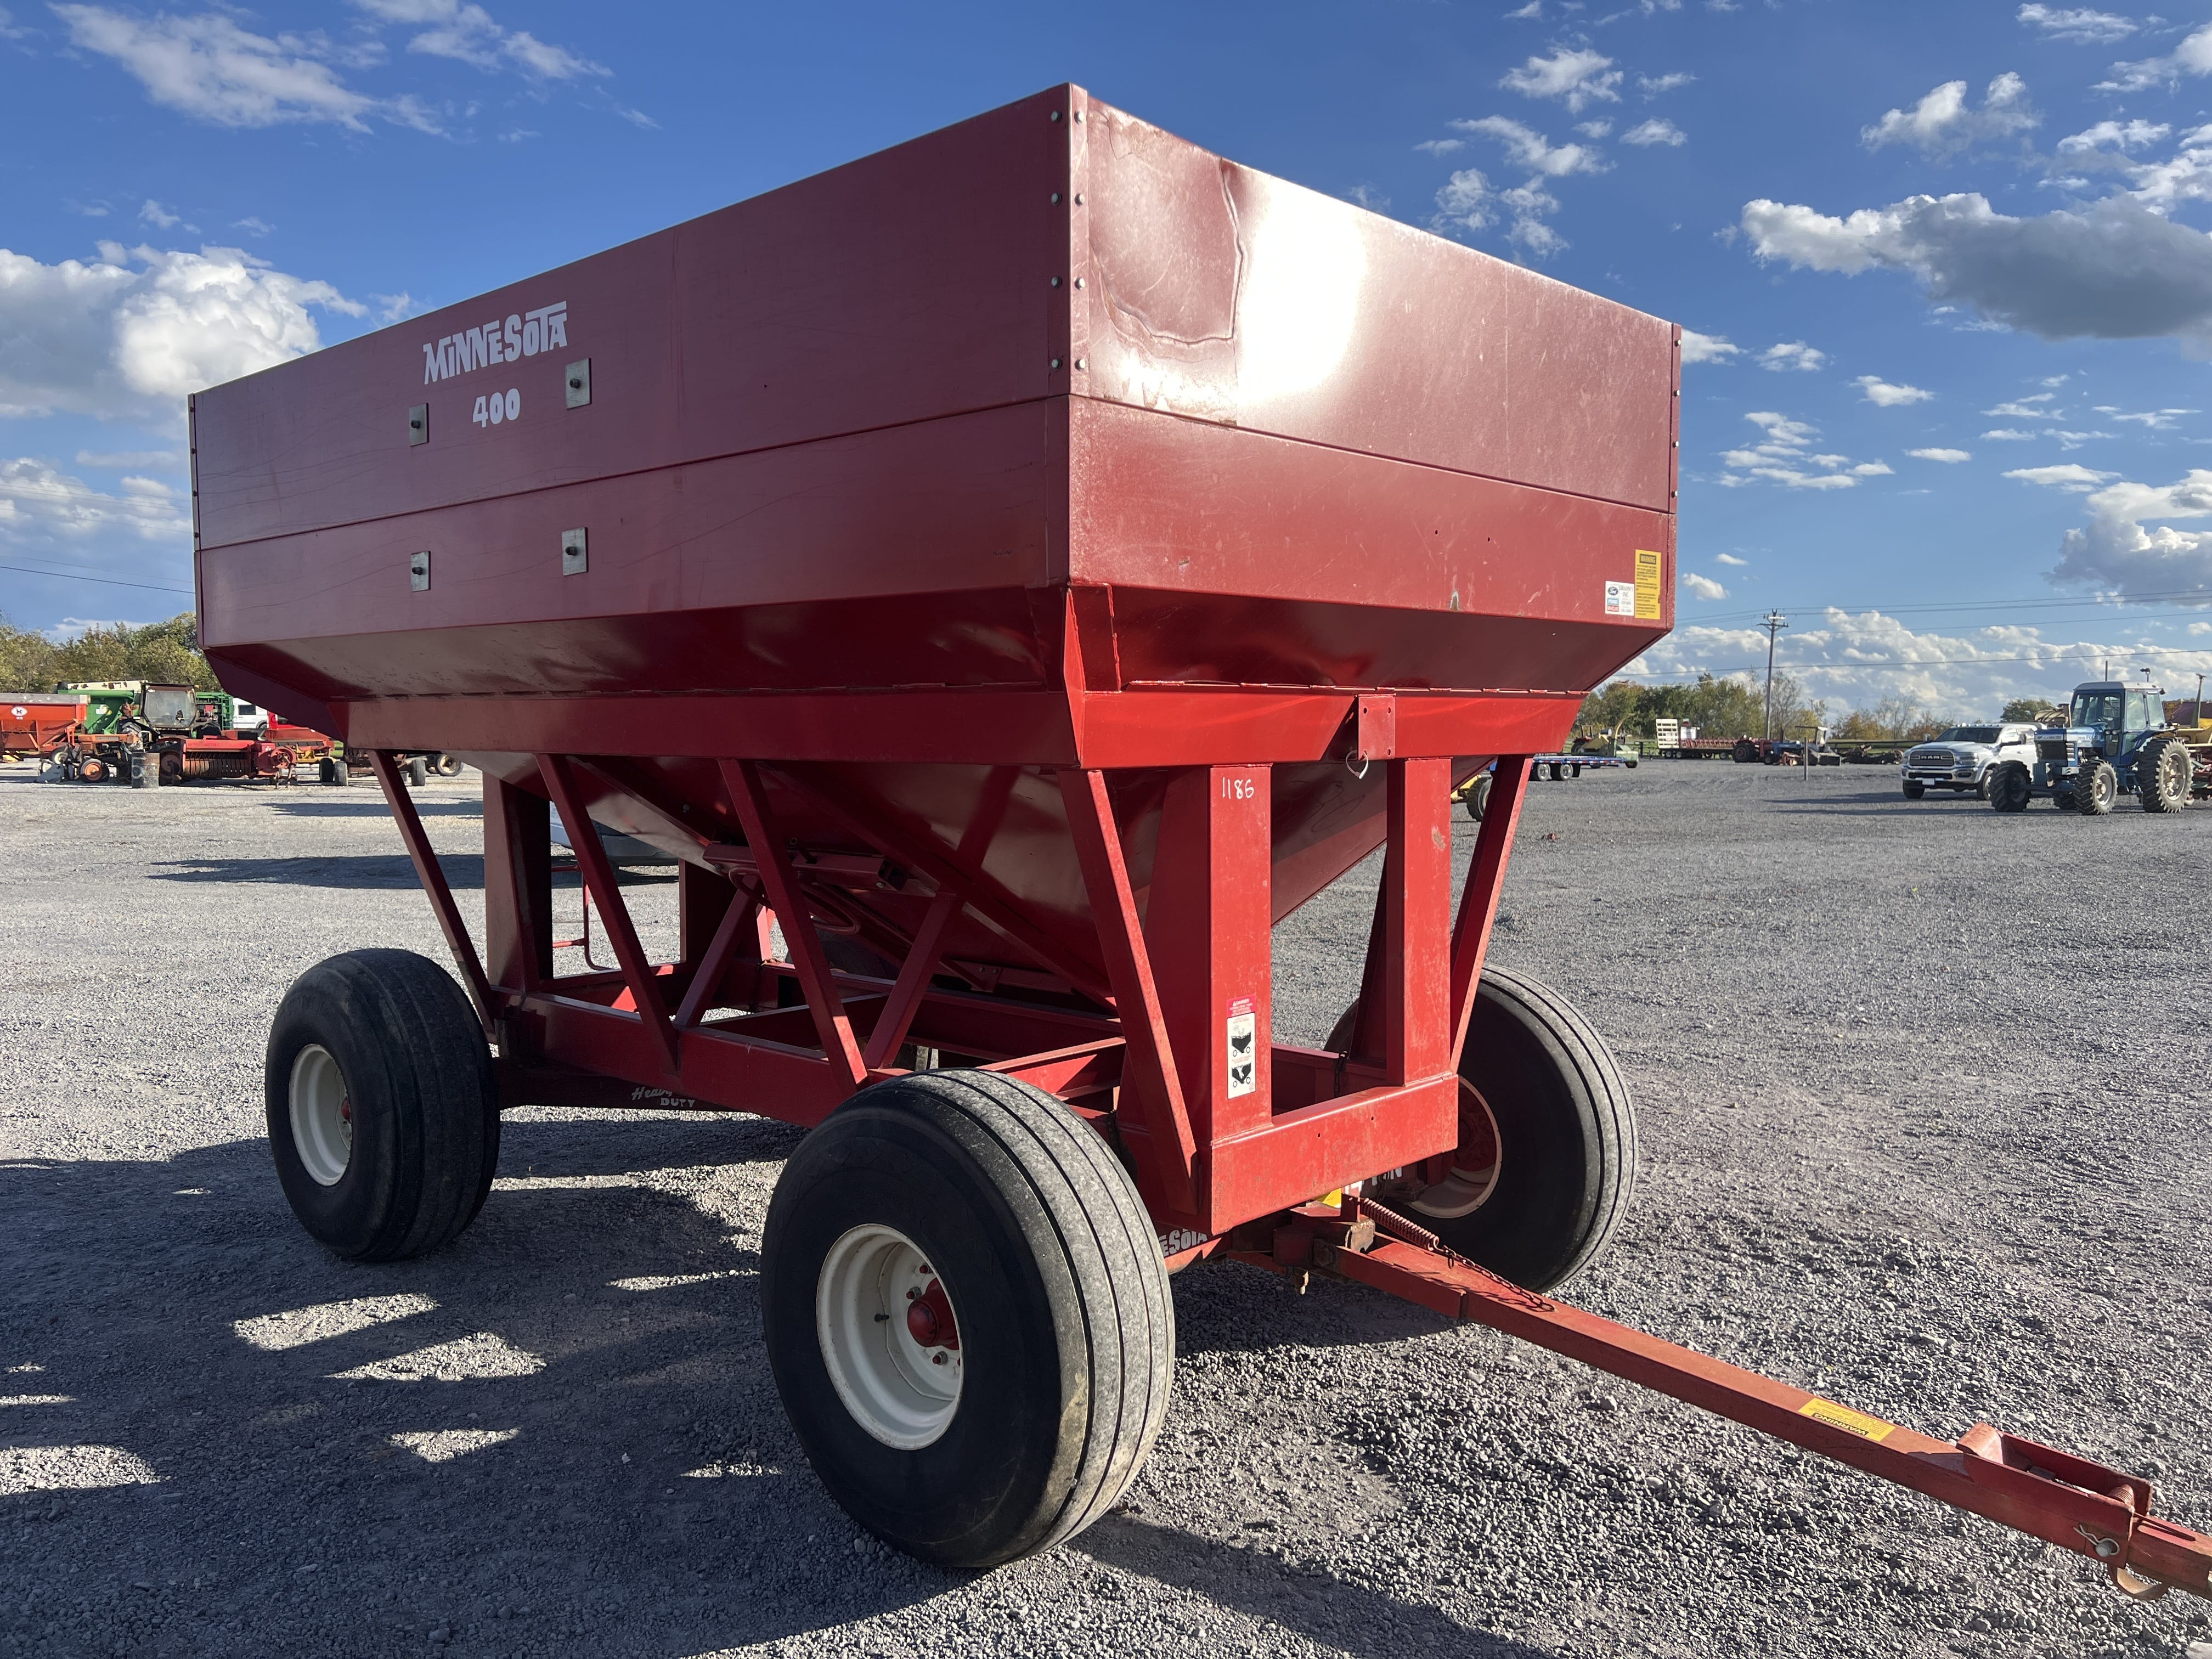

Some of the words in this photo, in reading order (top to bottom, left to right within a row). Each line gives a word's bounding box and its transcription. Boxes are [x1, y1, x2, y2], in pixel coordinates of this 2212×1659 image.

[422, 300, 567, 385] MINNESOTA
[472, 388, 521, 428] 400
[1222, 776, 1254, 799] 1186
[660, 1097, 695, 1107] DUTY
[1159, 1228, 1207, 1257] ESOTA
[1814, 1413, 1866, 1436] WARNING
